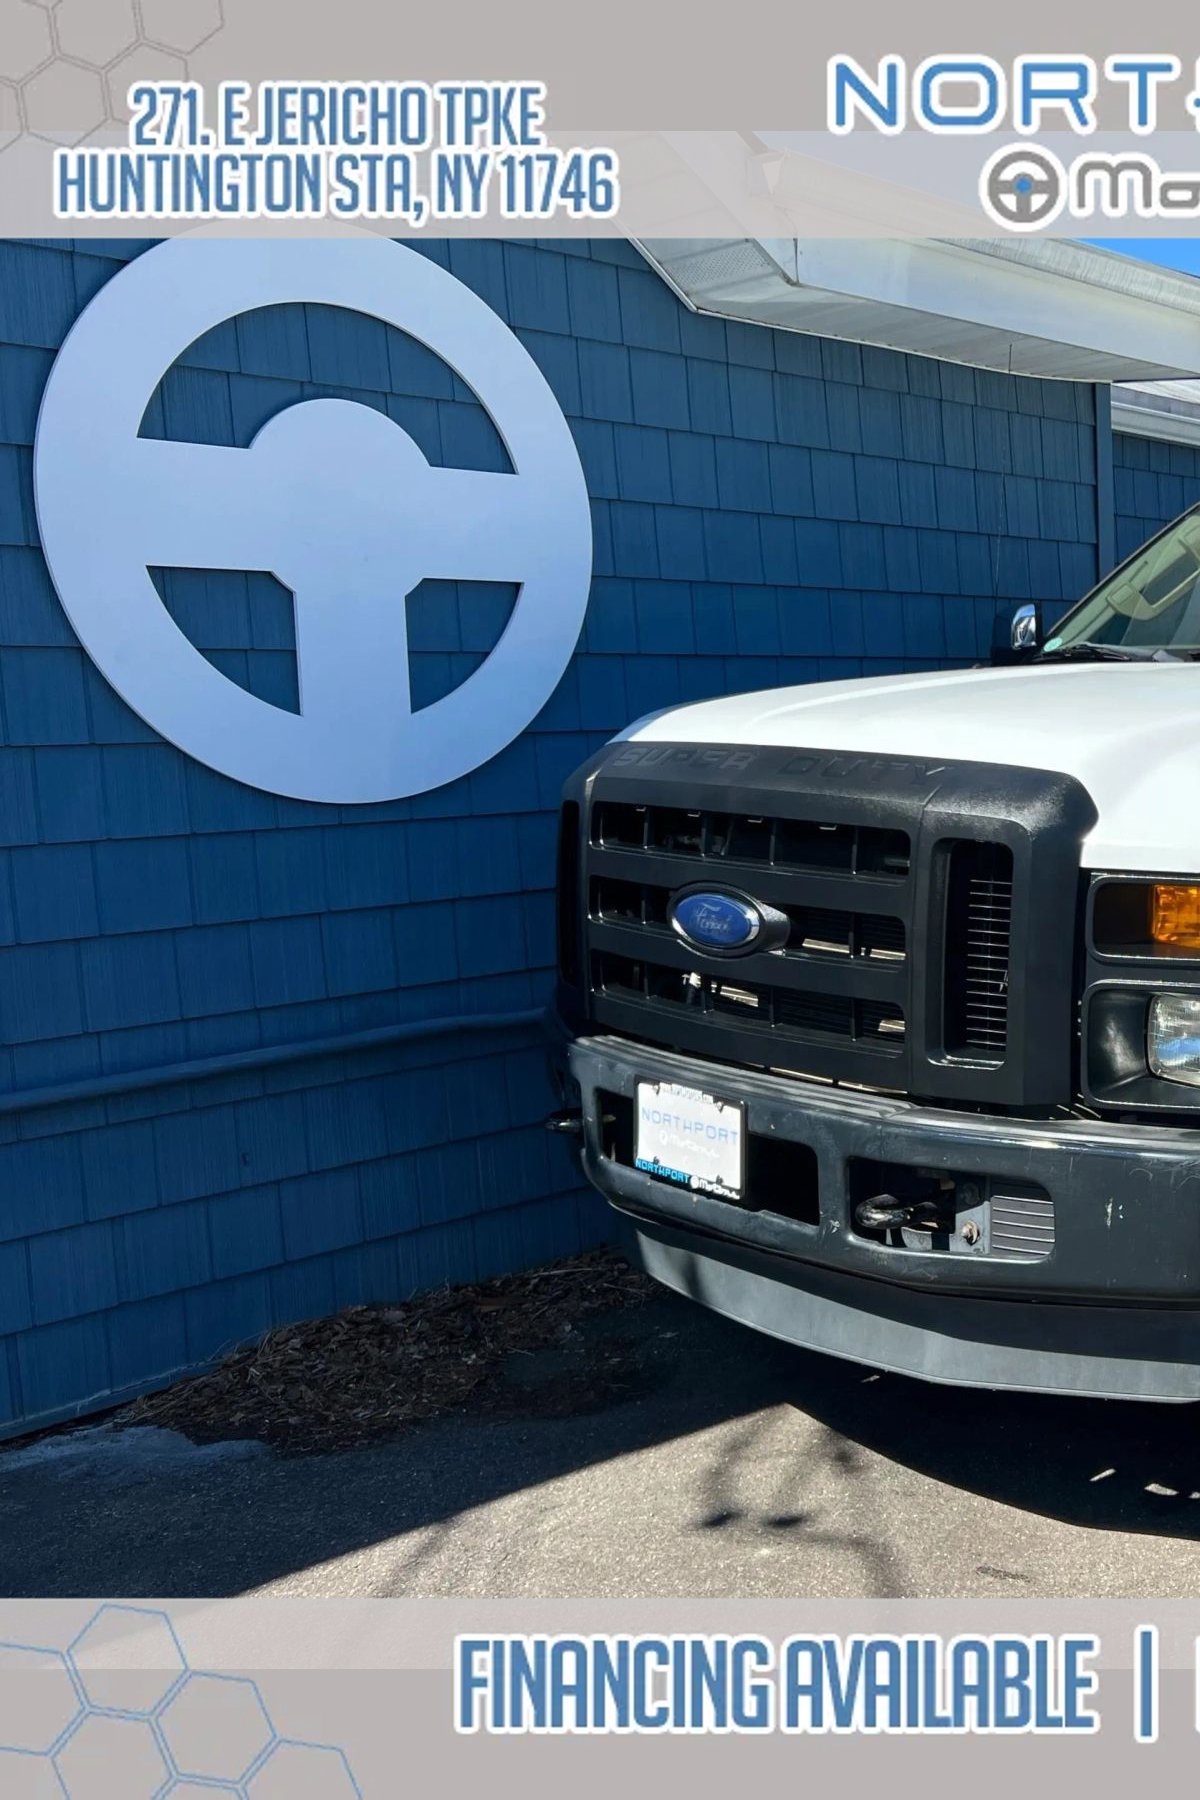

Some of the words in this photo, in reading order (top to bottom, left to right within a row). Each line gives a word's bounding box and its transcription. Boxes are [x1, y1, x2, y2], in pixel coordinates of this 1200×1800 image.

[613, 748, 755, 770] SUPER
[777, 754, 948, 786] DUTY
[642, 1109, 738, 1144] NORTHPORT
[635, 1160, 690, 1183] NORTHPORT
